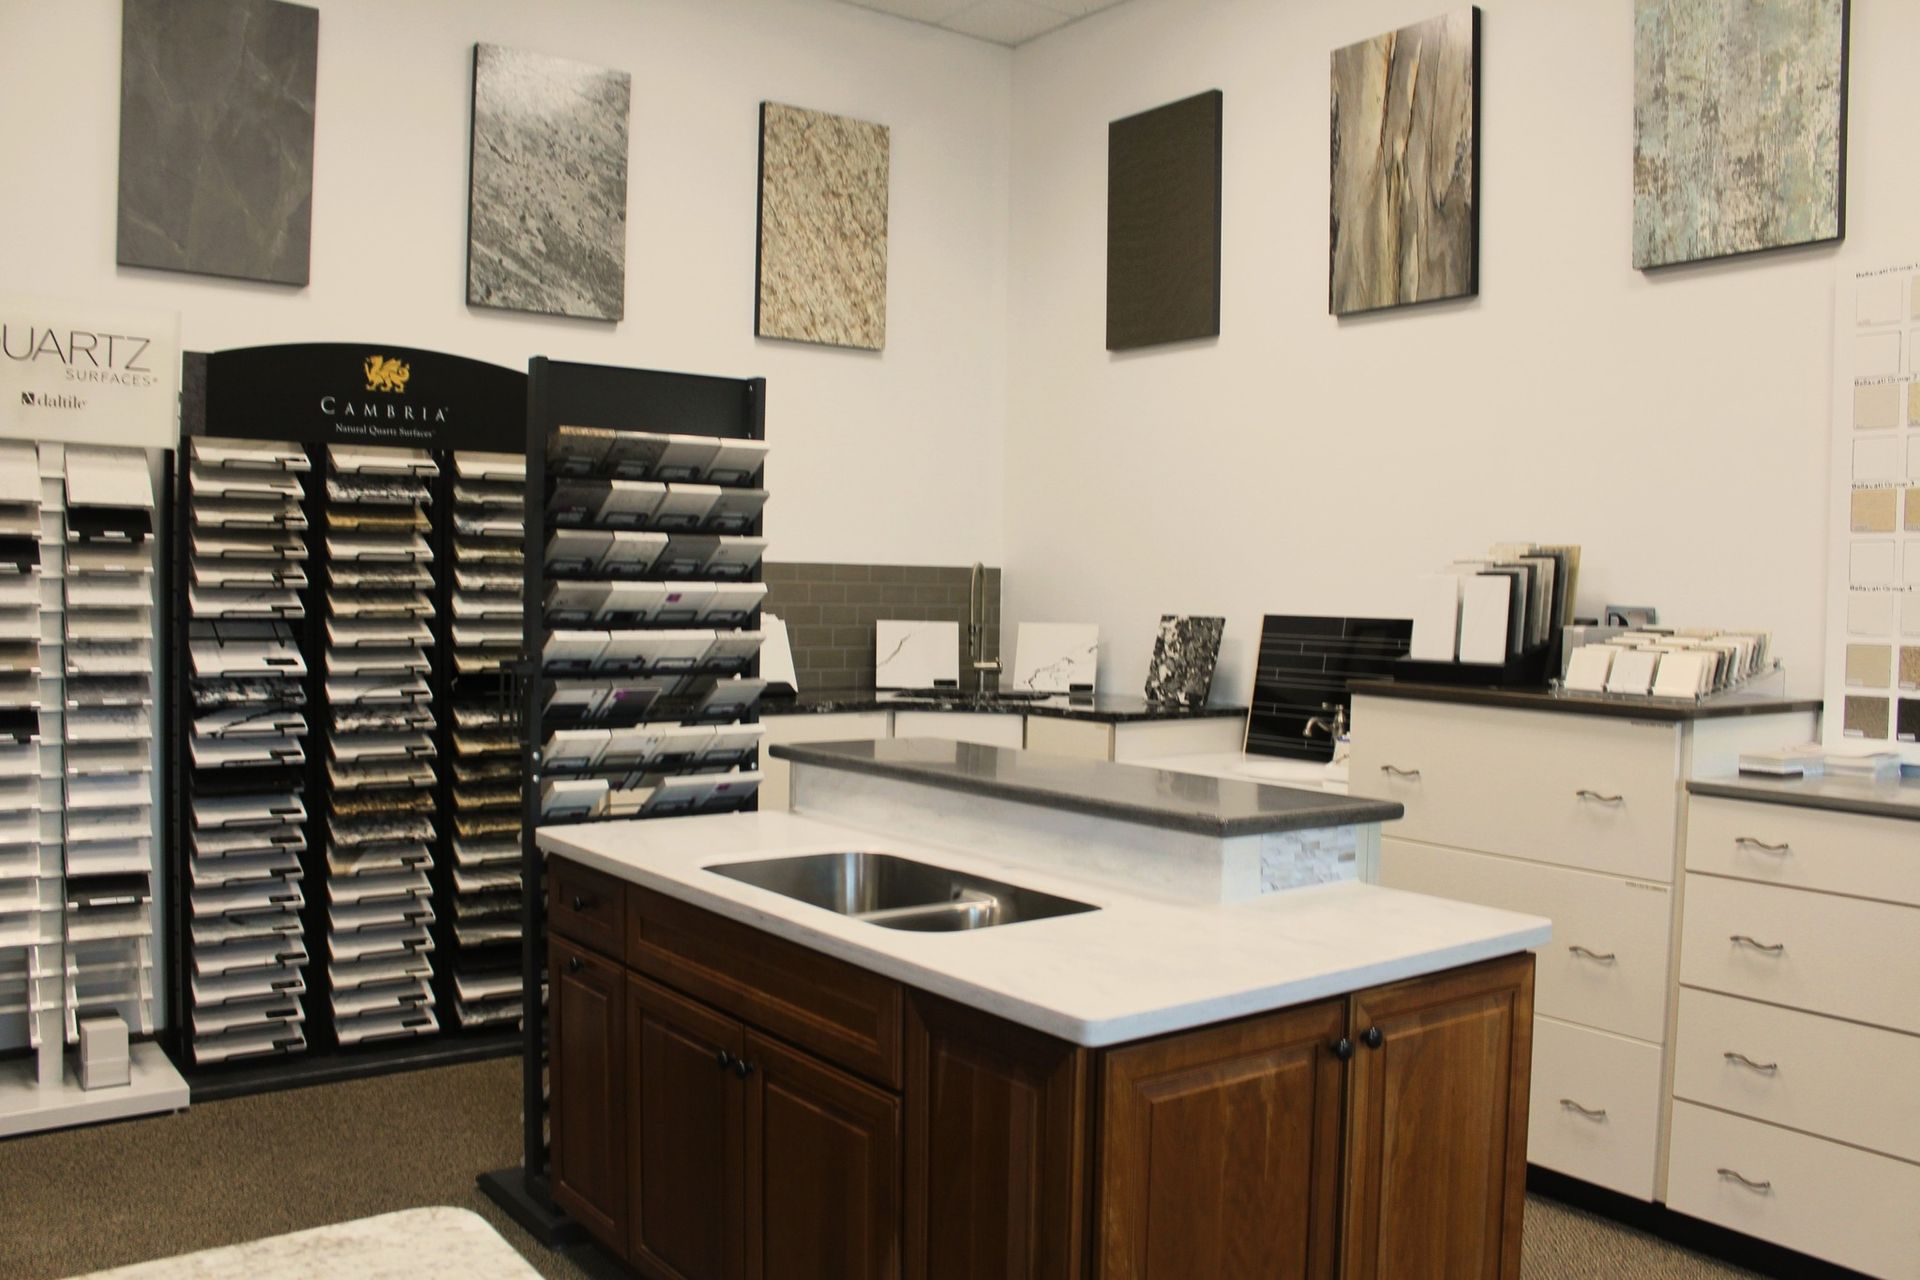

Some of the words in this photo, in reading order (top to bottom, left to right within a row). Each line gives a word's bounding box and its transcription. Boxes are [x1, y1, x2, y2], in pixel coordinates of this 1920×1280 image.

[0, 323, 150, 373] UARTZ
[38, 393, 85, 409] daltile
[335, 422, 367, 435] Natural
[369, 425, 397, 437] Quartz
